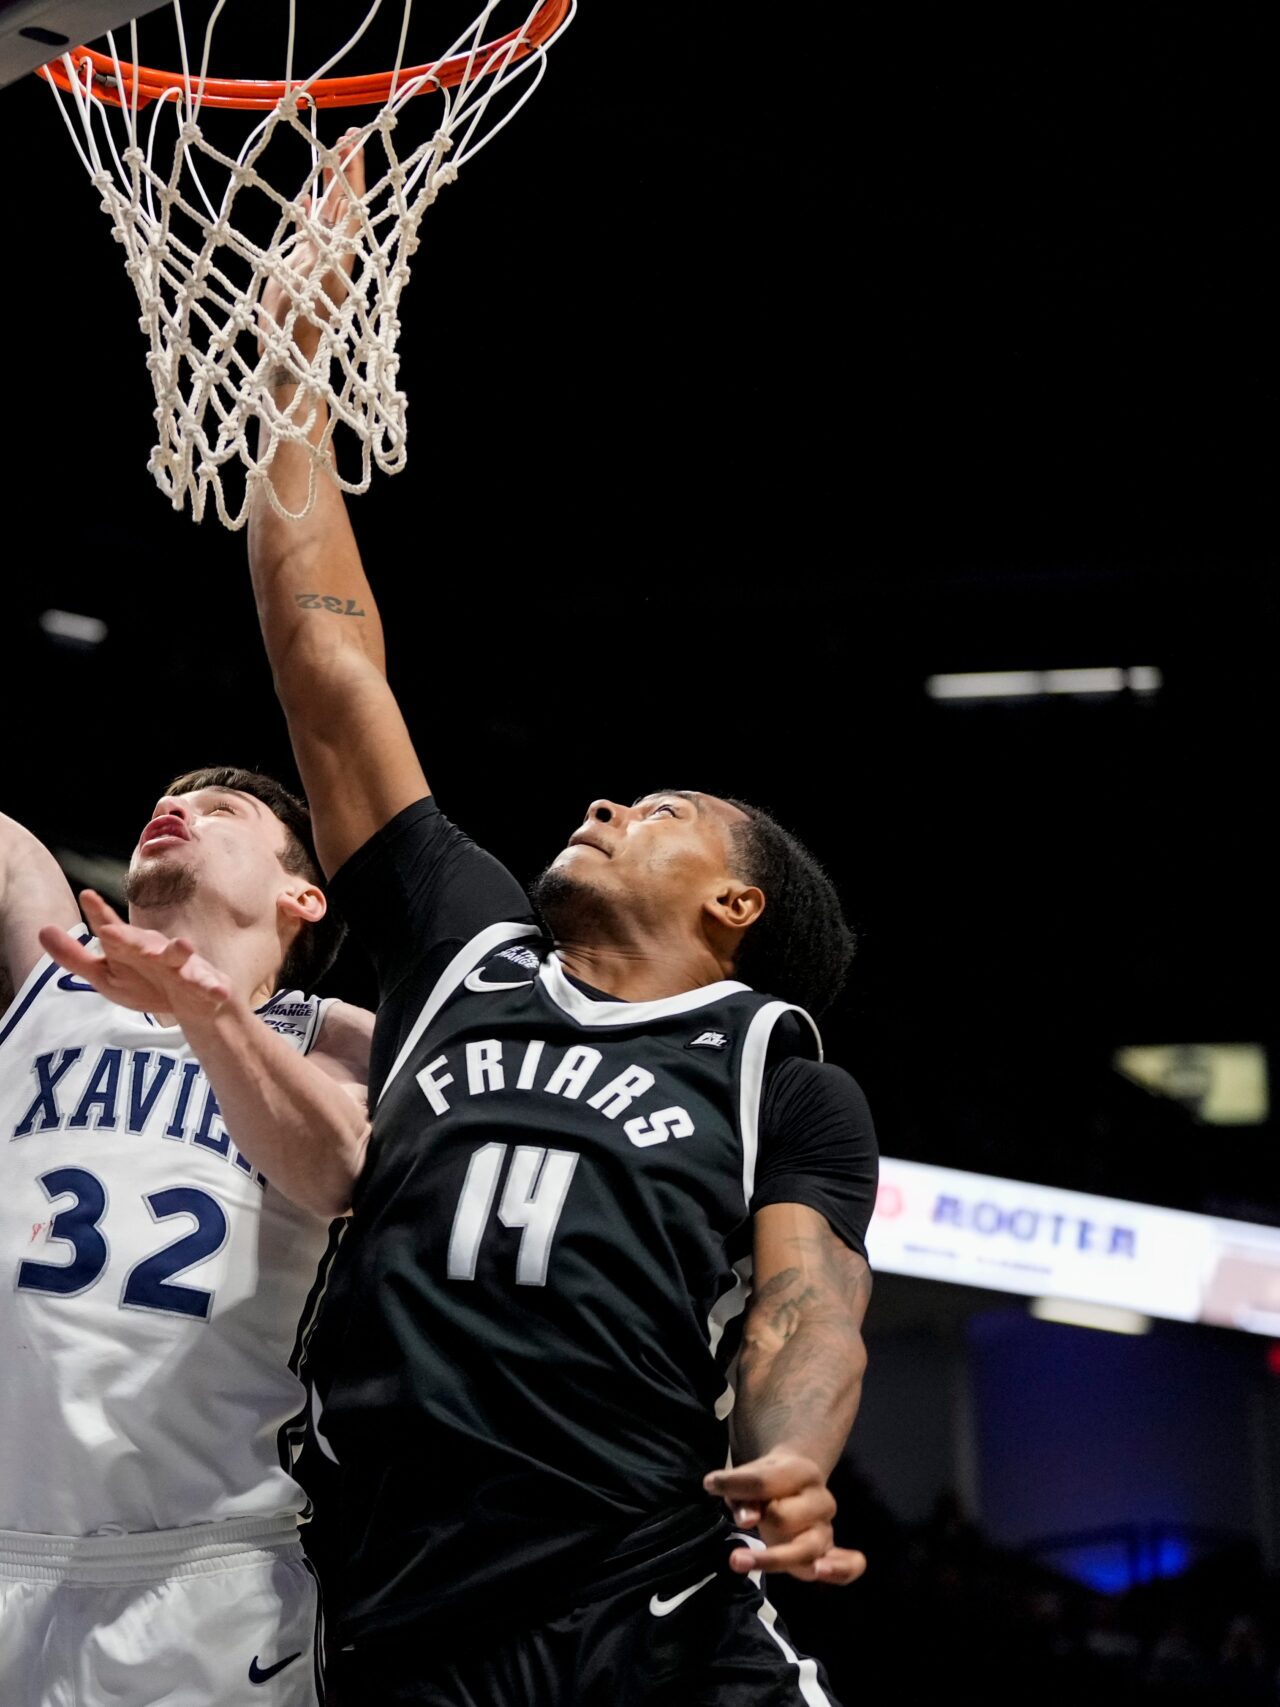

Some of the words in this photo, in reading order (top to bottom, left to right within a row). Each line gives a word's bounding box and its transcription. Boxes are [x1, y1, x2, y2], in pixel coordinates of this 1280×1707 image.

[272, 1026, 306, 1037] AST
[416, 1039, 695, 1148] FRIARS
[9, 1045, 267, 1192] XAVIE
[13, 1165, 230, 1323] 32
[447, 1142, 580, 1287] 14
